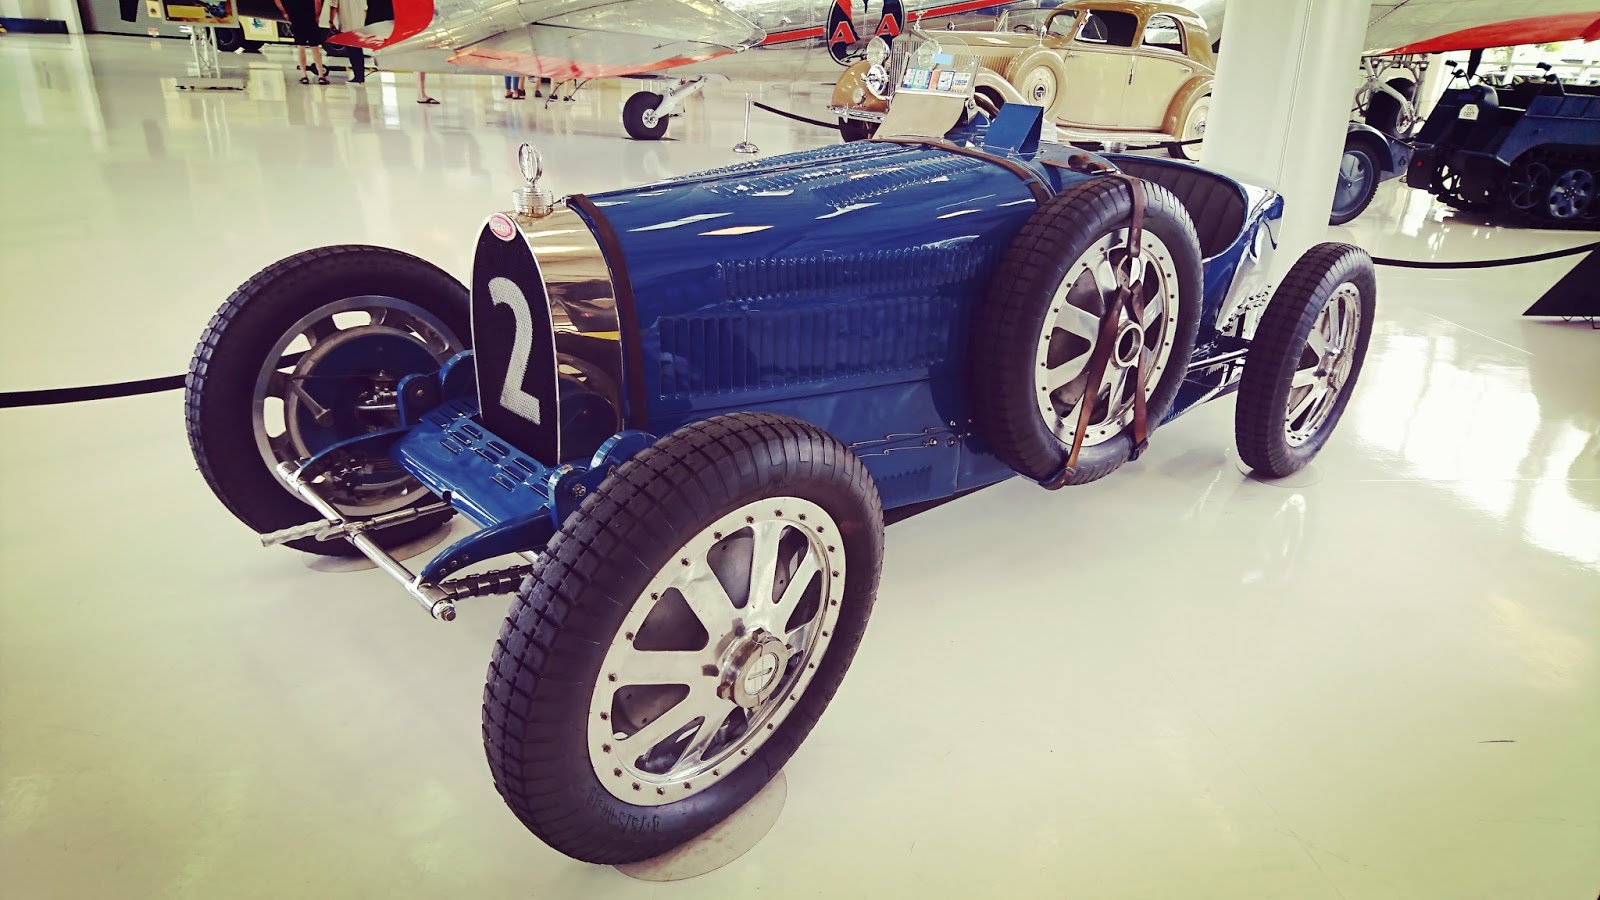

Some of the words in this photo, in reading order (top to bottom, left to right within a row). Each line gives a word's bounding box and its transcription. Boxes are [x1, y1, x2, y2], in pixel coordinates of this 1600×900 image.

[830, 21, 856, 48] A
[875, 13, 900, 37] A
[488, 277, 541, 425] 2
